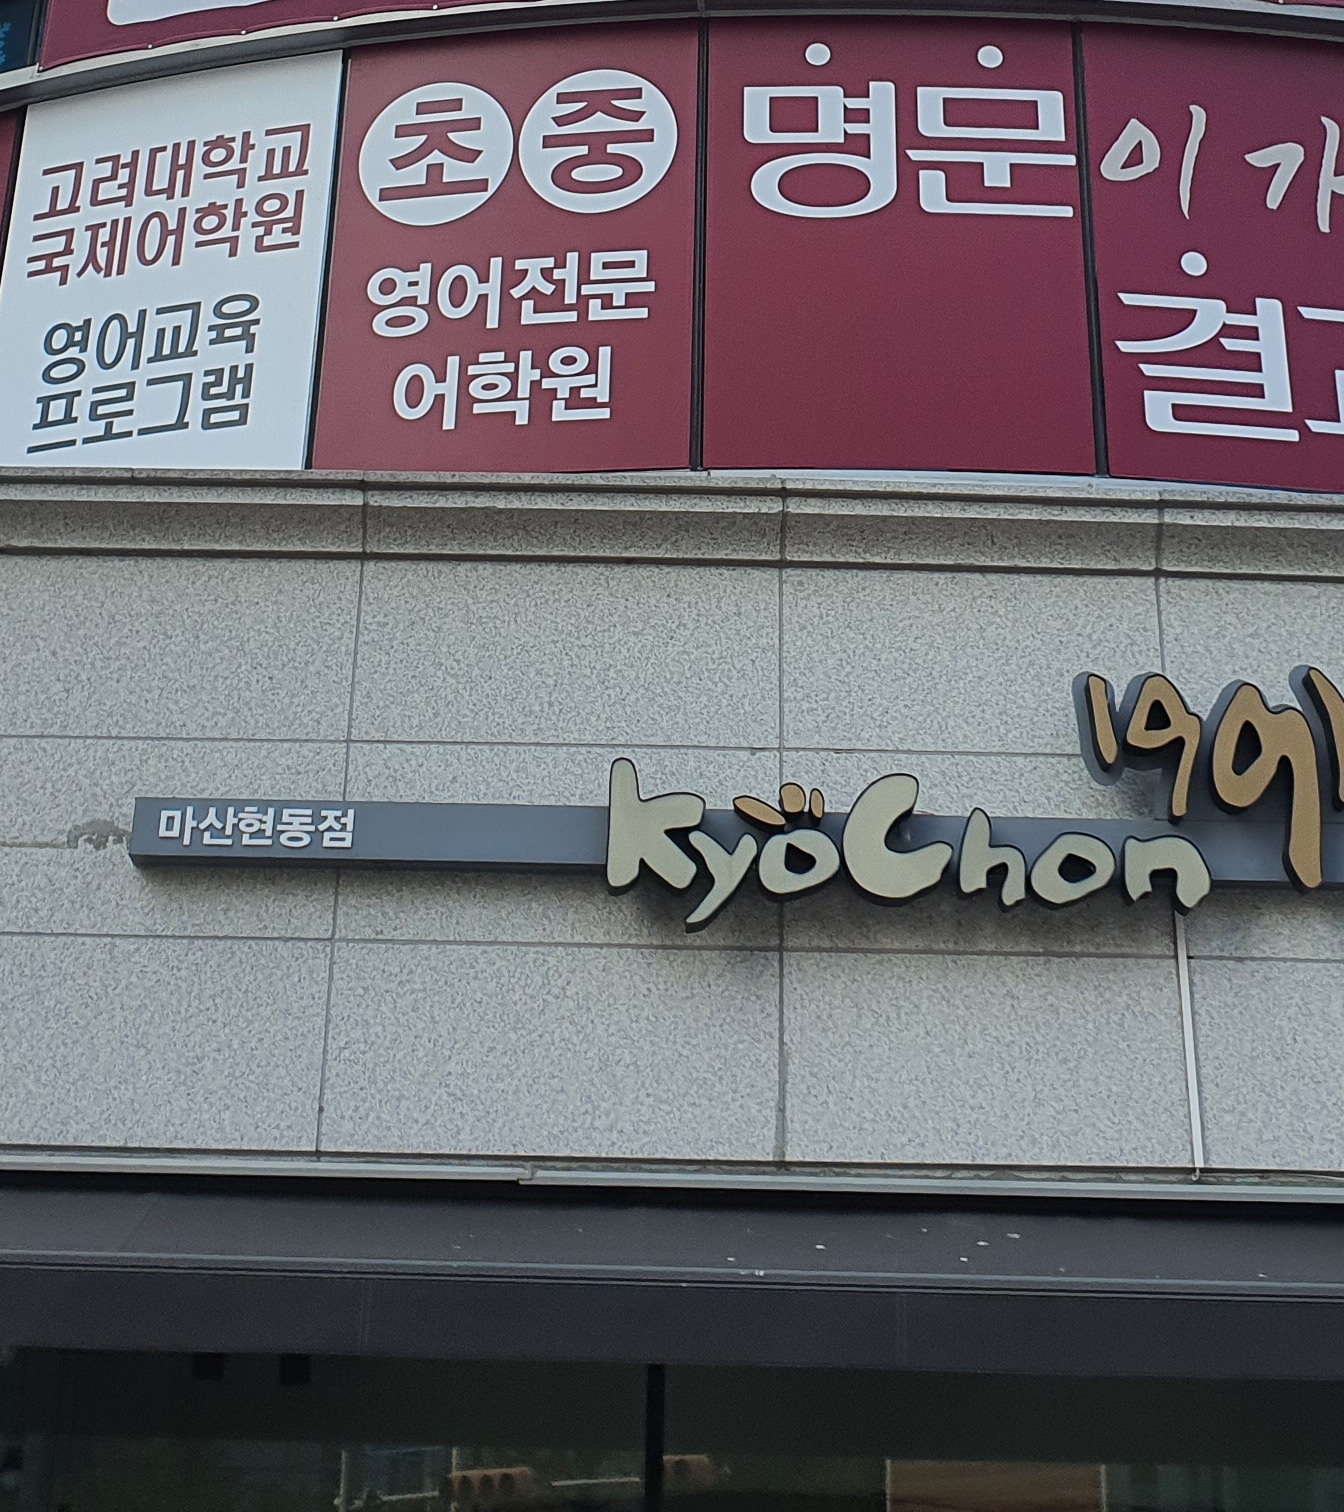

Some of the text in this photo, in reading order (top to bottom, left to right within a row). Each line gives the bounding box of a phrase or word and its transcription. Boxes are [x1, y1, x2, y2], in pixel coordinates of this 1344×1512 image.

[33, 123, 311, 222] 고려대학교
[377, 86, 655, 203] 초 중
[26, 189, 305, 287] 국제어학원
[42, 293, 261, 384] 영어교육
[366, 249, 656, 338] 영어전문
[26, 362, 254, 454] 프로그램
[392, 344, 613, 431] 어학원
[158, 805, 357, 850] 마산현동점
